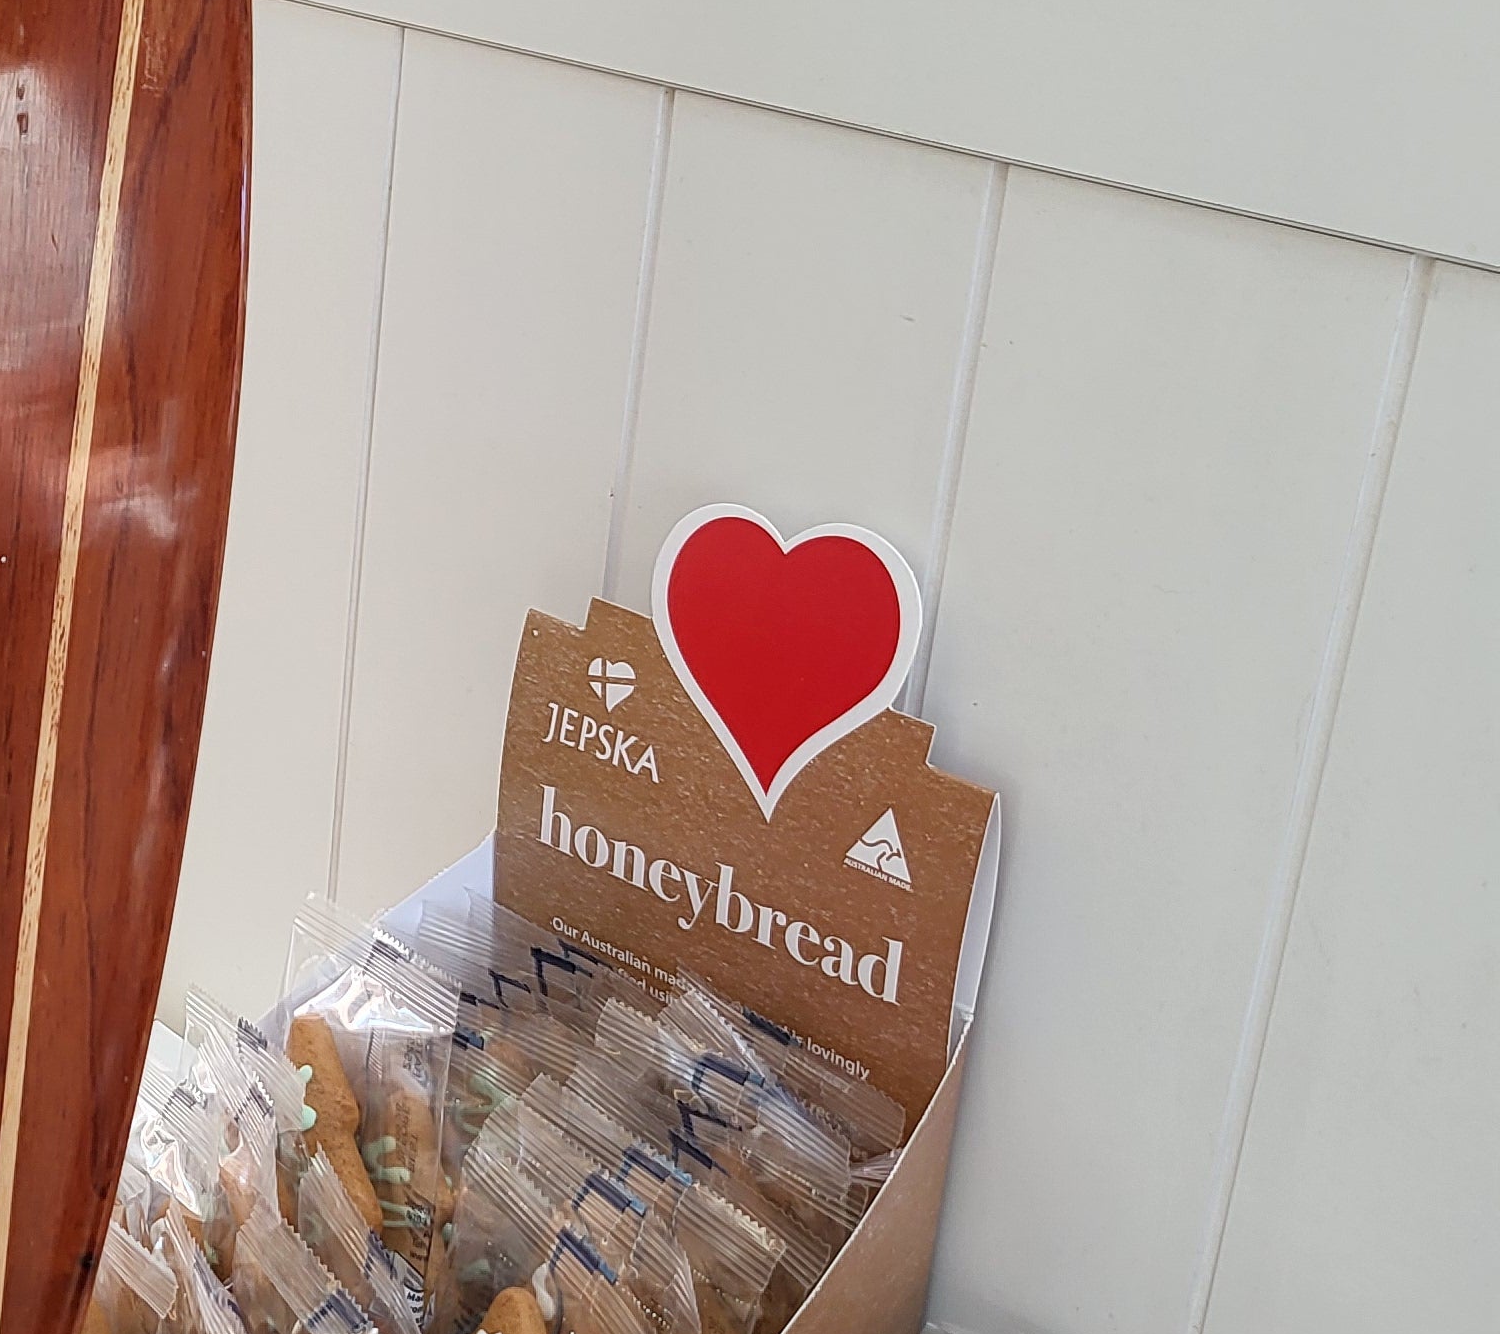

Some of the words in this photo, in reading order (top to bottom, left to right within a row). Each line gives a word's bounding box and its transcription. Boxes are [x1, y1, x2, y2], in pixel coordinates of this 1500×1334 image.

[542, 702, 661, 784] JEPSKA
[536, 783, 904, 1006] honeybread
[843, 858, 888, 883] AUSTRALIAN
[888, 876, 911, 892] MADE
[552, 917, 579, 940] Our
[581, 930, 652, 974] Australian
[806, 1036, 871, 1081] lovingly
